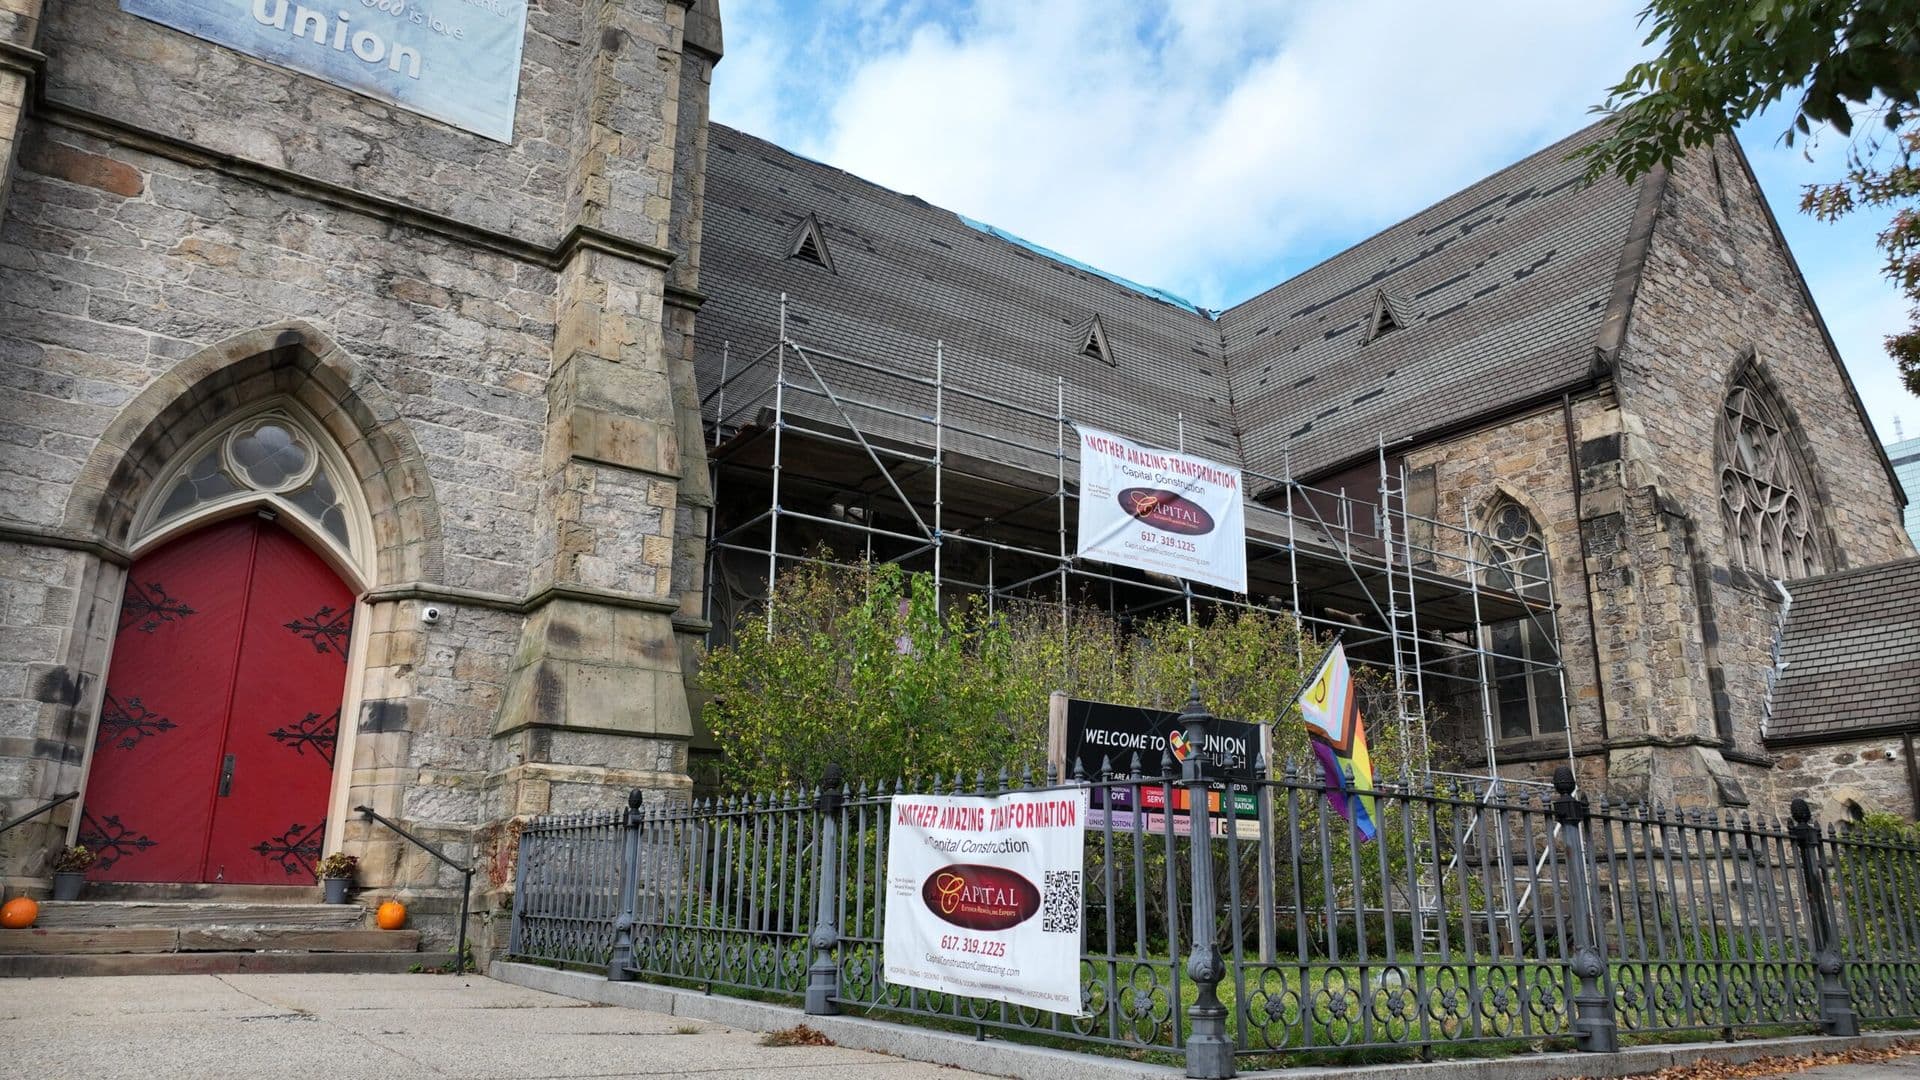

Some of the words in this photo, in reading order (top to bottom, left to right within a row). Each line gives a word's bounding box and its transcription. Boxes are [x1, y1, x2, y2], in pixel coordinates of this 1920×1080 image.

[252, 0, 422, 80] union
[427, 12, 465, 41] love
[1122, 465, 1153, 482] Capital
[1155, 473, 1206, 496] Construction
[1128, 449, 1168, 471] AMAZING
[1169, 457, 1237, 489] TRANFORMATION
[1130, 490, 1200, 524] CAPITAL
[1085, 728, 1147, 750] WELCOME
[1150, 735, 1166, 751] TO
[1111, 792, 1126, 801] OVE
[898, 803, 938, 828] ANOTHER
[939, 807, 984, 832] AMAZING
[928, 836, 961, 854] Capital
[961, 837, 1030, 855] Construction
[937, 873, 1019, 914] CAPITAL
